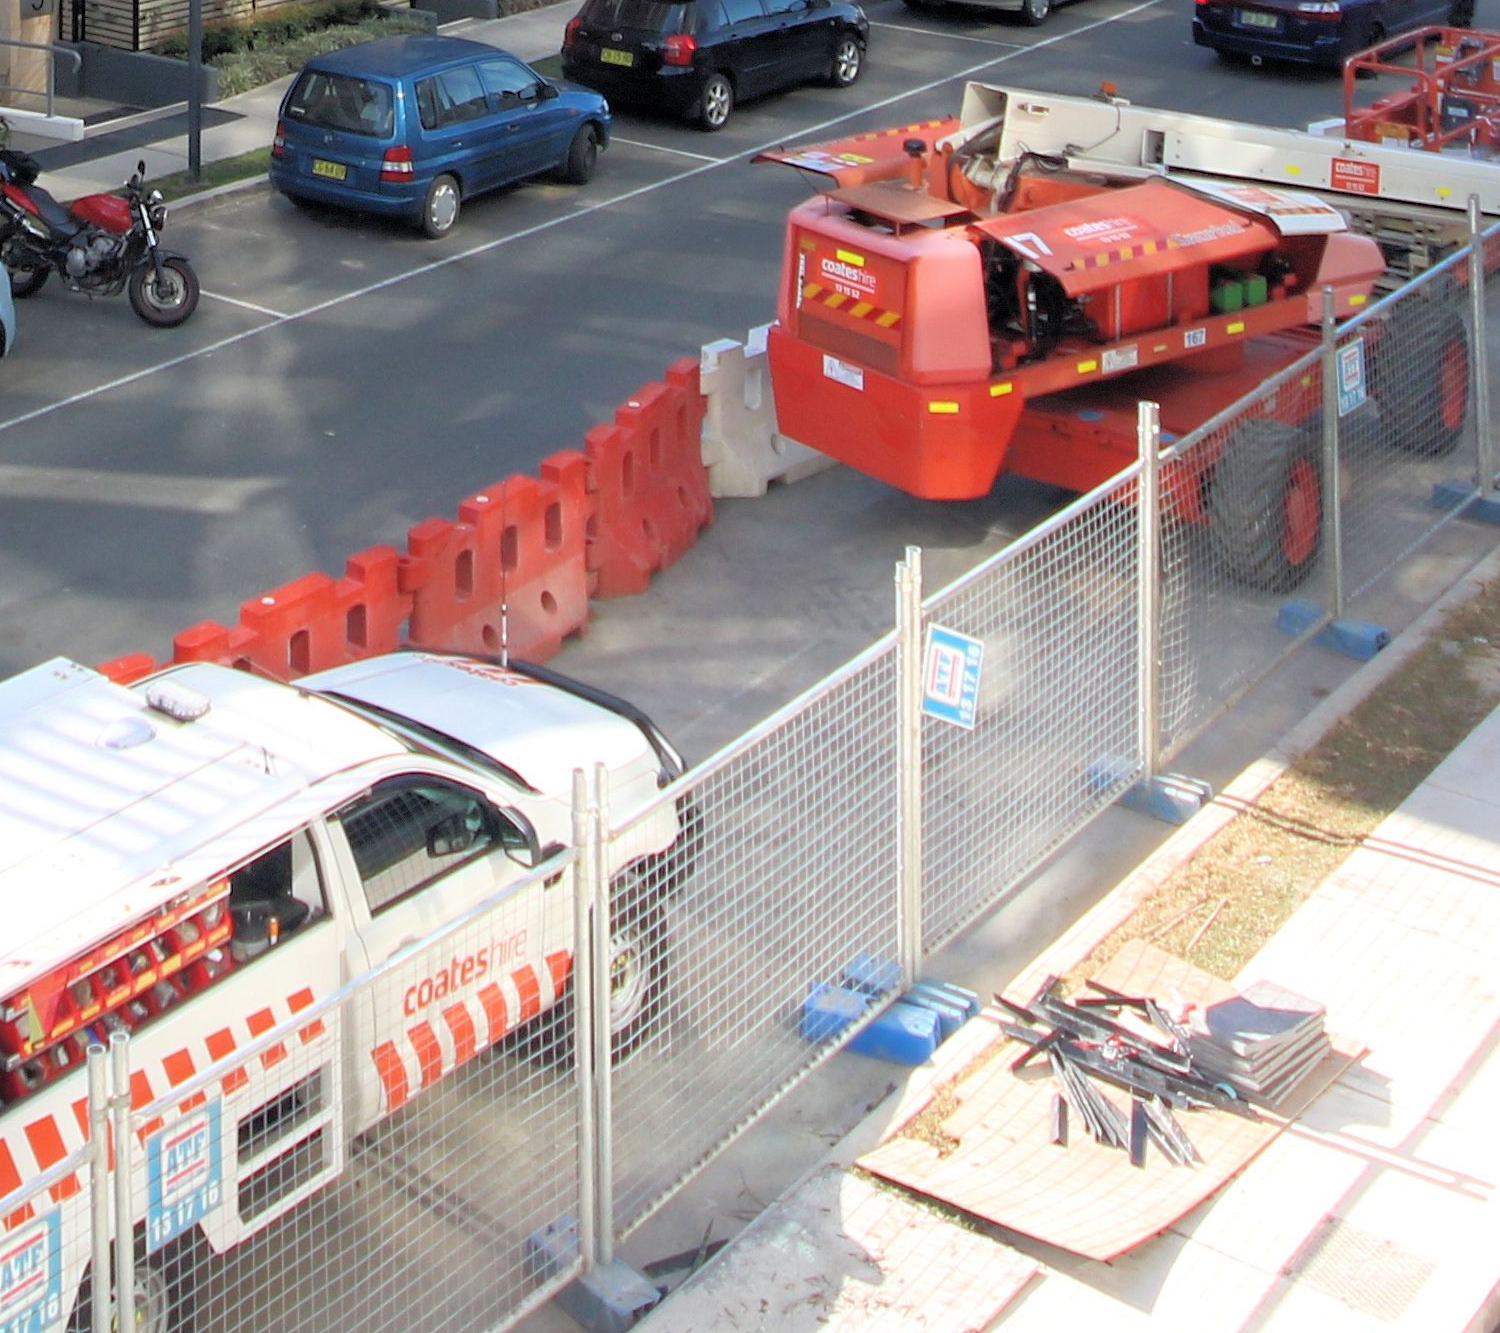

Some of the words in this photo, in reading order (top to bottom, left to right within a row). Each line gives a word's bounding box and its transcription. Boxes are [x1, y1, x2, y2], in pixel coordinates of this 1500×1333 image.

[404, 929, 527, 1018] coateshire
[152, 1209, 172, 1242] 13
[177, 1194, 197, 1227] 17
[201, 1179, 220, 1211] 16
[39, 1292, 60, 1325] 16
